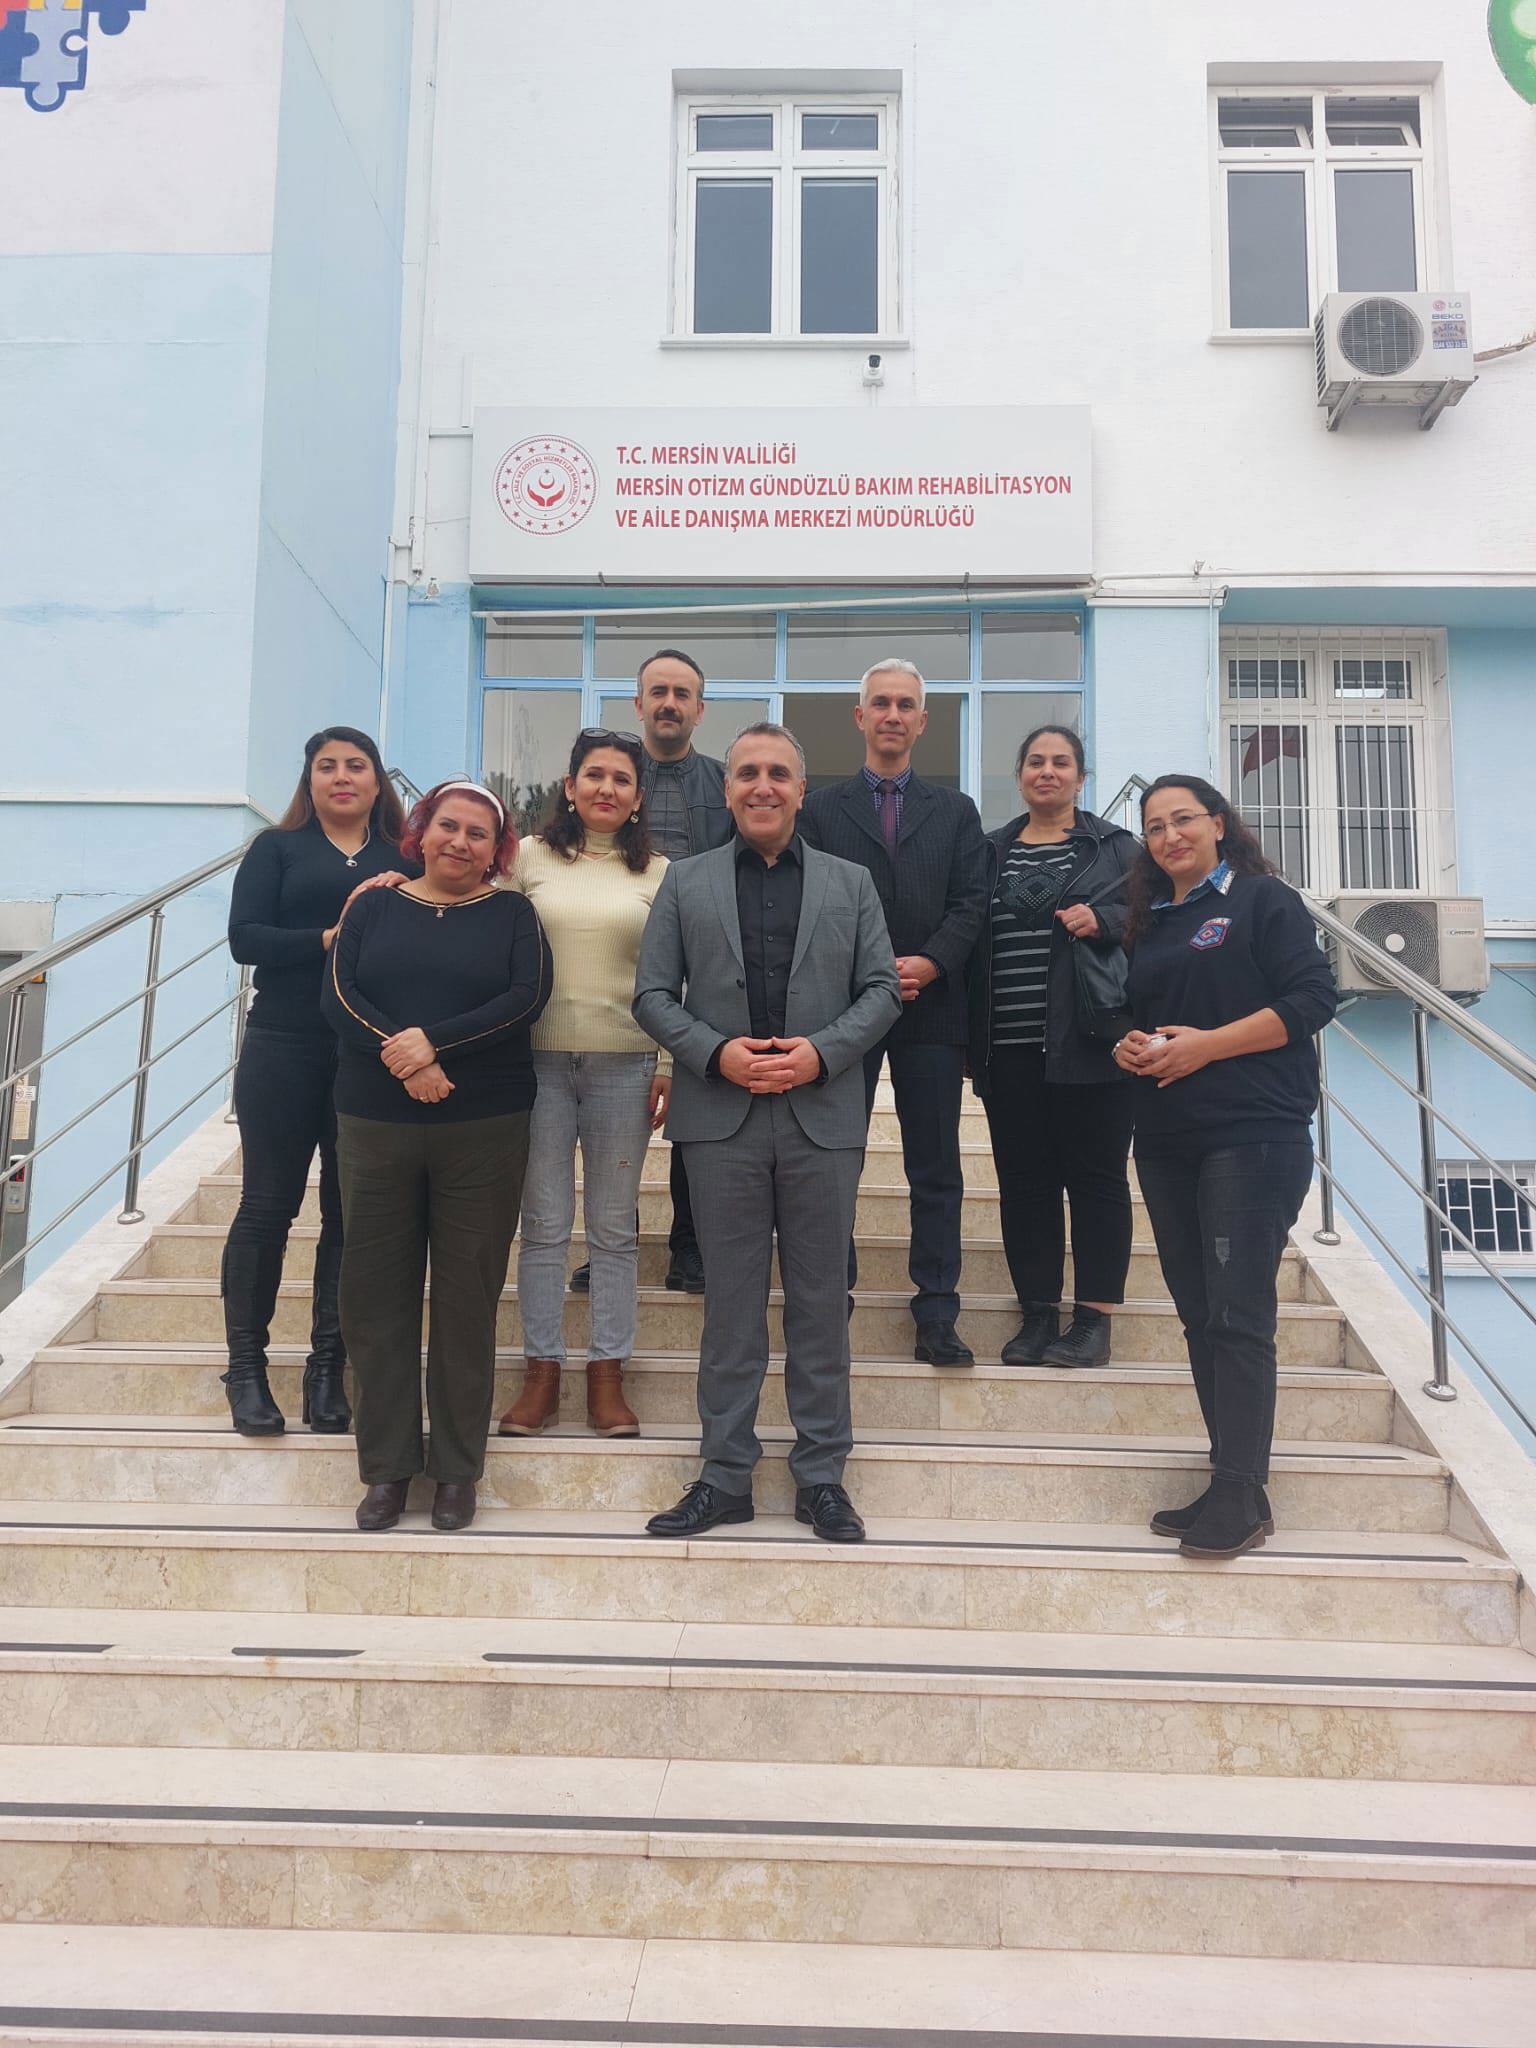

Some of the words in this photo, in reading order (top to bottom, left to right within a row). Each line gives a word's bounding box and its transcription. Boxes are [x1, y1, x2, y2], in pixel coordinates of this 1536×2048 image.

[617, 446, 647, 465] T.C.
[652, 443, 719, 465] MERSİN
[723, 443, 797, 465] VALİLİĞİ
[616, 474, 684, 496] MERSİN
[688, 474, 745, 496] OTİZM
[750, 474, 851, 497] GÜNDÜZLÜ
[855, 477, 913, 496] BAKIM
[918, 473, 1072, 496] REHABİLİTASYON
[616, 509, 638, 528] VE
[642, 506, 681, 528] AİLE
[685, 509, 769, 532] DANIŞMA
[774, 506, 853, 528] MERKEZİ
[856, 505, 975, 528] MÜDÜRLÜĞÜ
